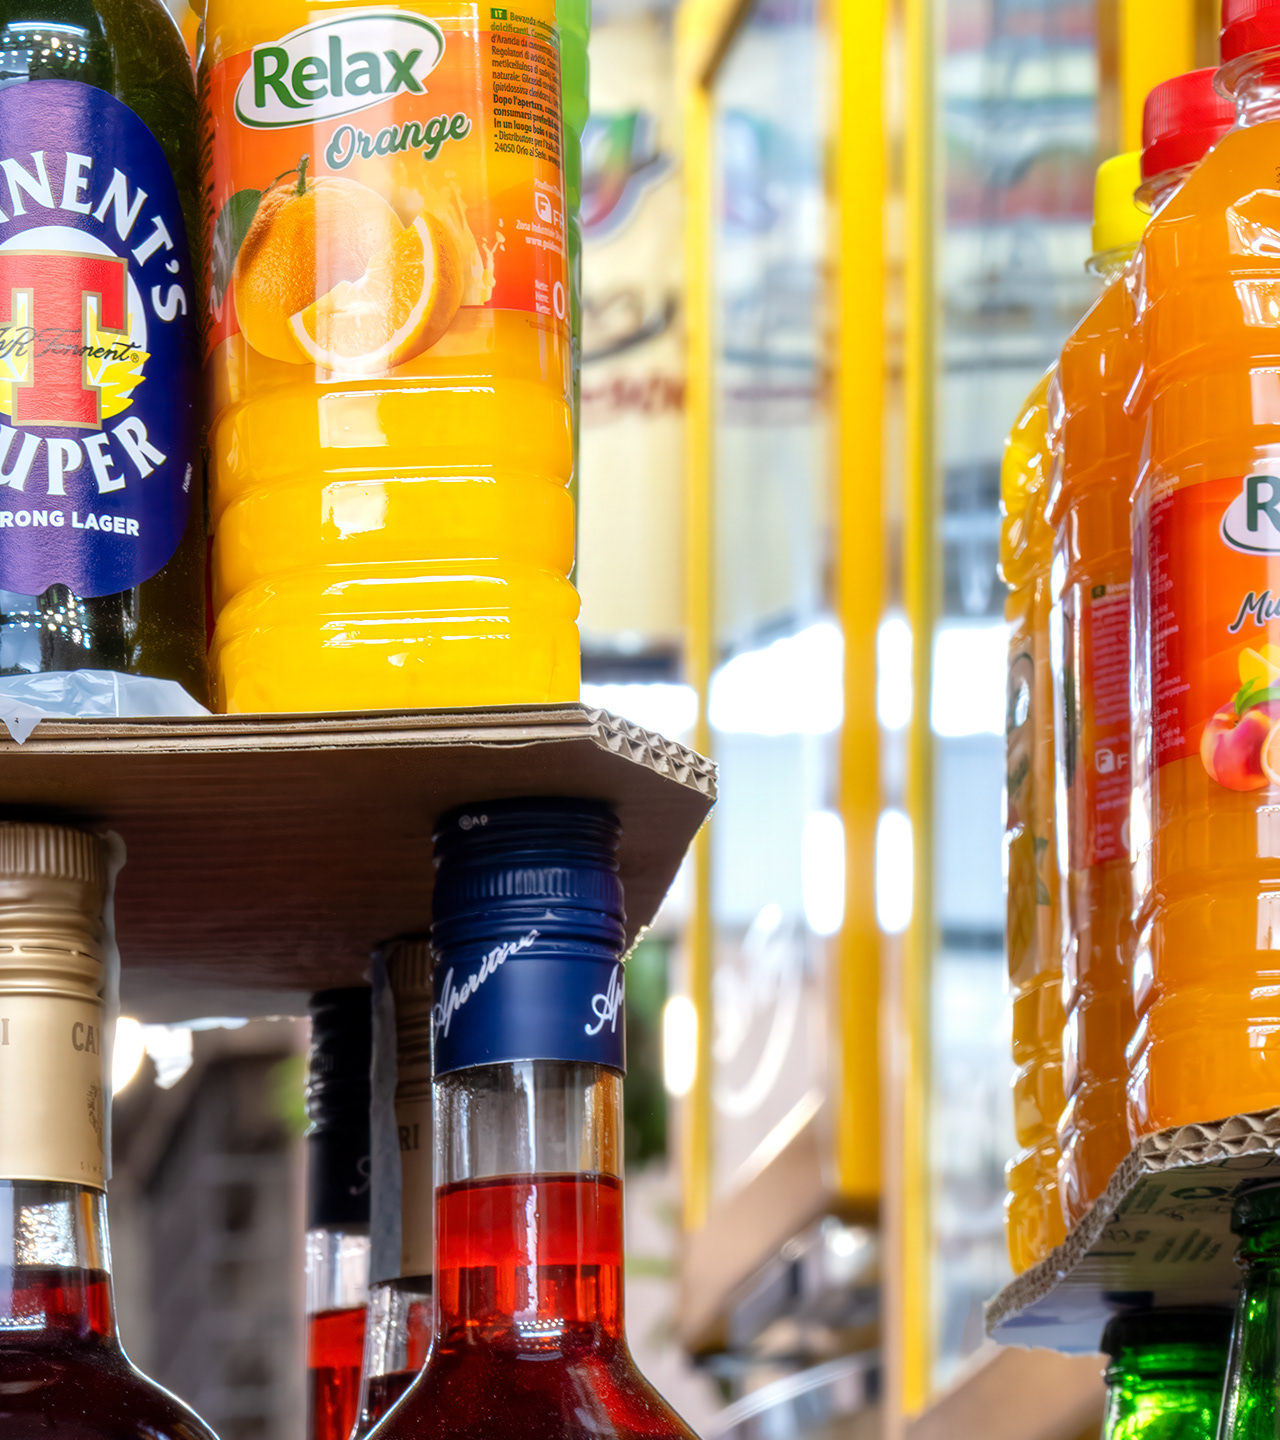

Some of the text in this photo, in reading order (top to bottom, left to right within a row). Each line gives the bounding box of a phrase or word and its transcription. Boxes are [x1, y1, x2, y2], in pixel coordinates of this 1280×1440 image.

[251, 34, 426, 101] Relax
[325, 111, 472, 170] Orange
[71, 510, 141, 538] LAGER
